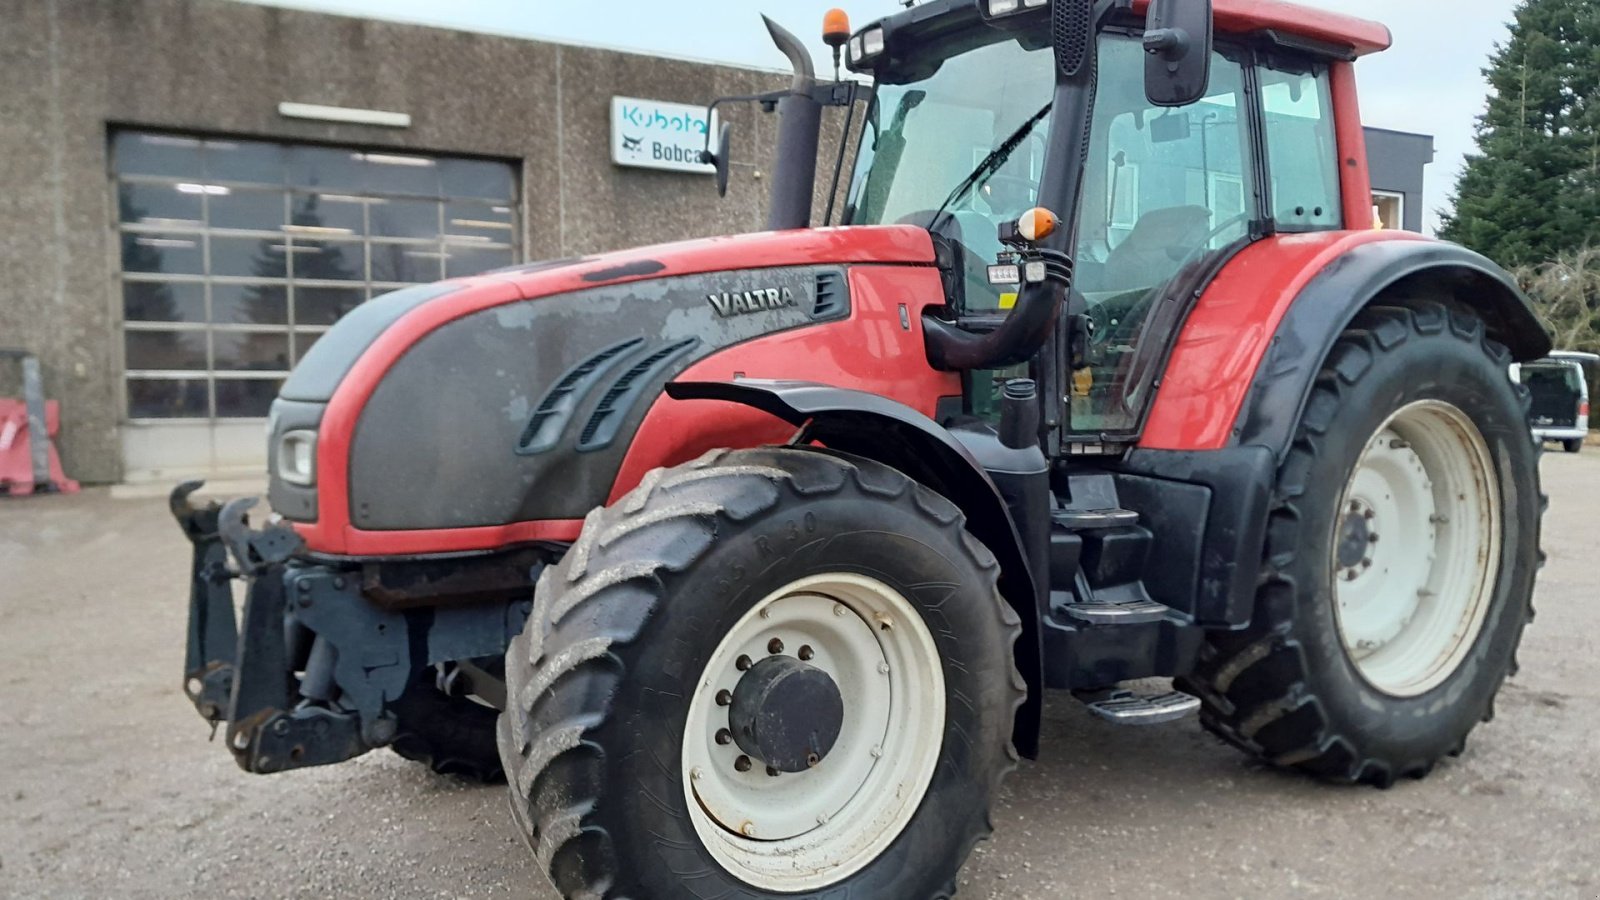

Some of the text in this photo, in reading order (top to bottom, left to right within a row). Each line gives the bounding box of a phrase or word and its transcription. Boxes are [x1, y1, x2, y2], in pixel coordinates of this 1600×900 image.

[623, 105, 708, 134] Kubota
[652, 141, 704, 164] Bobca
[706, 287, 799, 318] VALTRA
